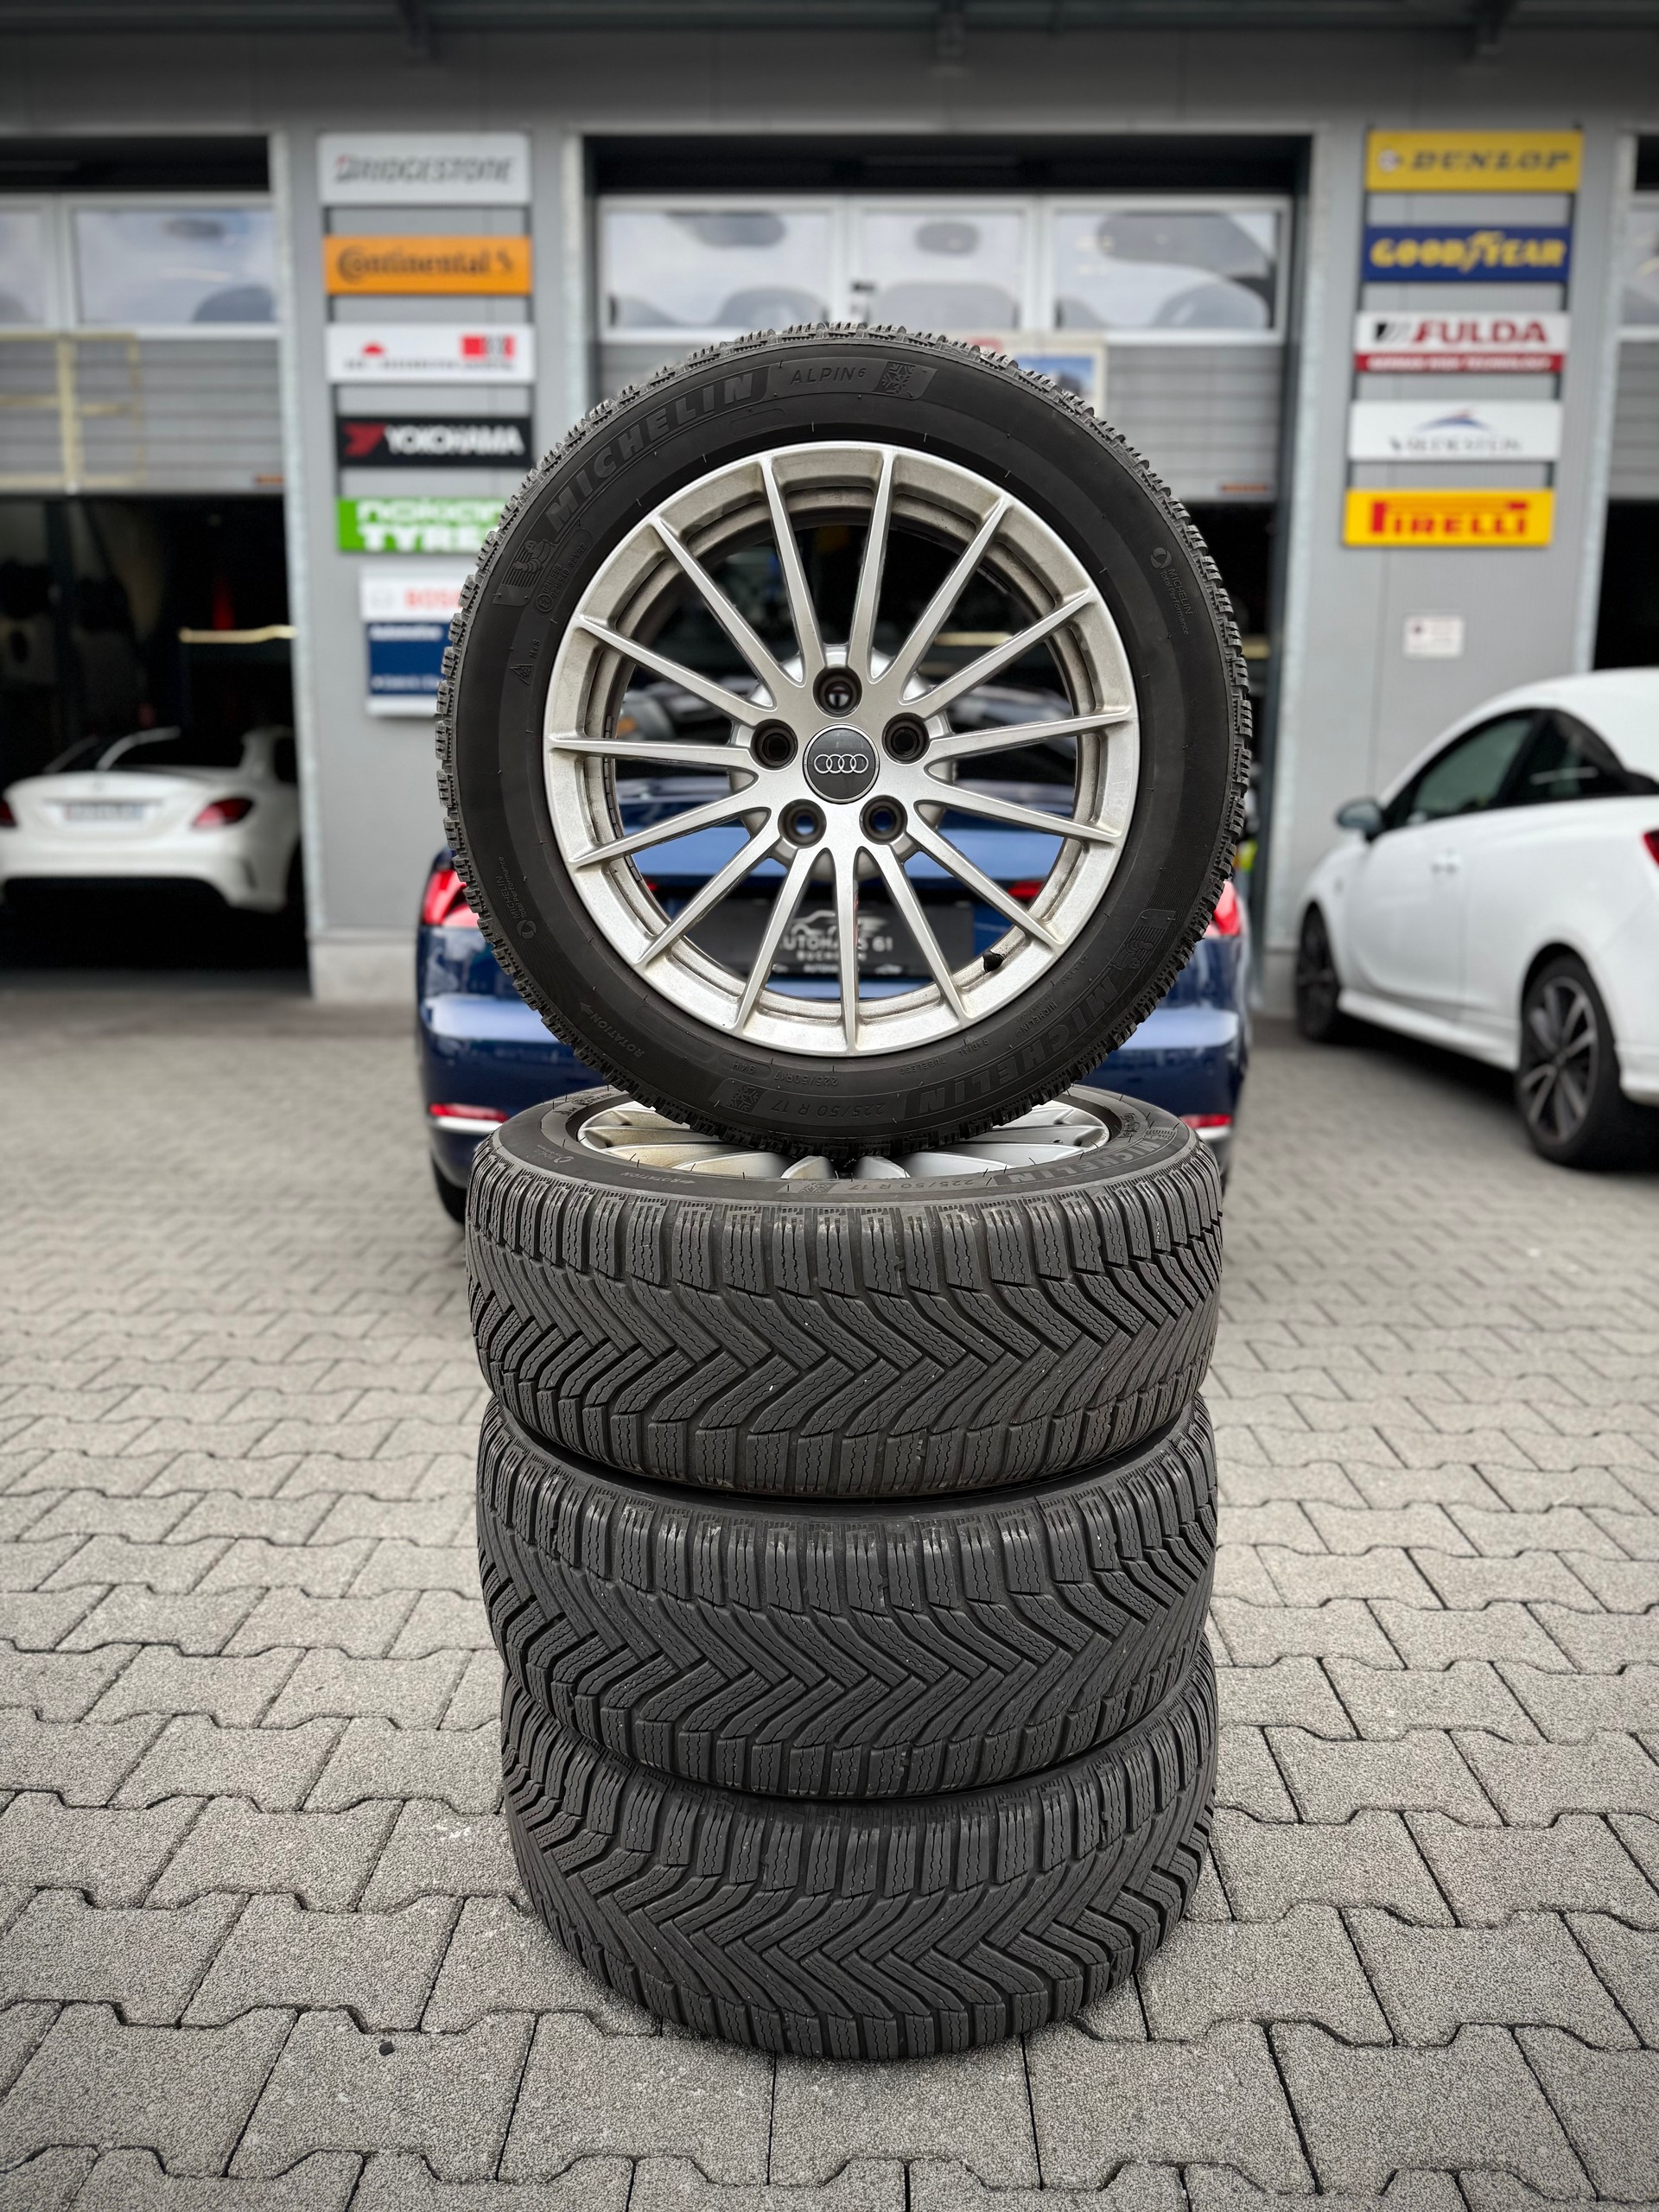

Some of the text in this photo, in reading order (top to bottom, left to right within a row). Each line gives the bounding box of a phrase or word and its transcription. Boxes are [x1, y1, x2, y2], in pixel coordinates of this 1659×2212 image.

[1411, 149, 1571, 170] DUNLOP
[1370, 230, 1567, 274] GOODYEAR
[1412, 321, 1548, 344] FULDA
[385, 424, 525, 454] YOKOHAMA
[545, 372, 754, 533] MICHELIN
[1370, 499, 1529, 536] PIRELLI
[358, 527, 486, 551] TYRE
[1167, 567, 1193, 615] MICHELIN
[495, 874, 521, 920] MICHELIN
[590, 1013, 645, 1058] ROTATION
[918, 976, 1119, 1114] MICHELIN
[957, 1037, 989, 1057] RADIAL
[770, 1098, 790, 1113] 17
[816, 1103, 887, 1117] 225/50
[1008, 1140, 1162, 1183] MICHELIN
